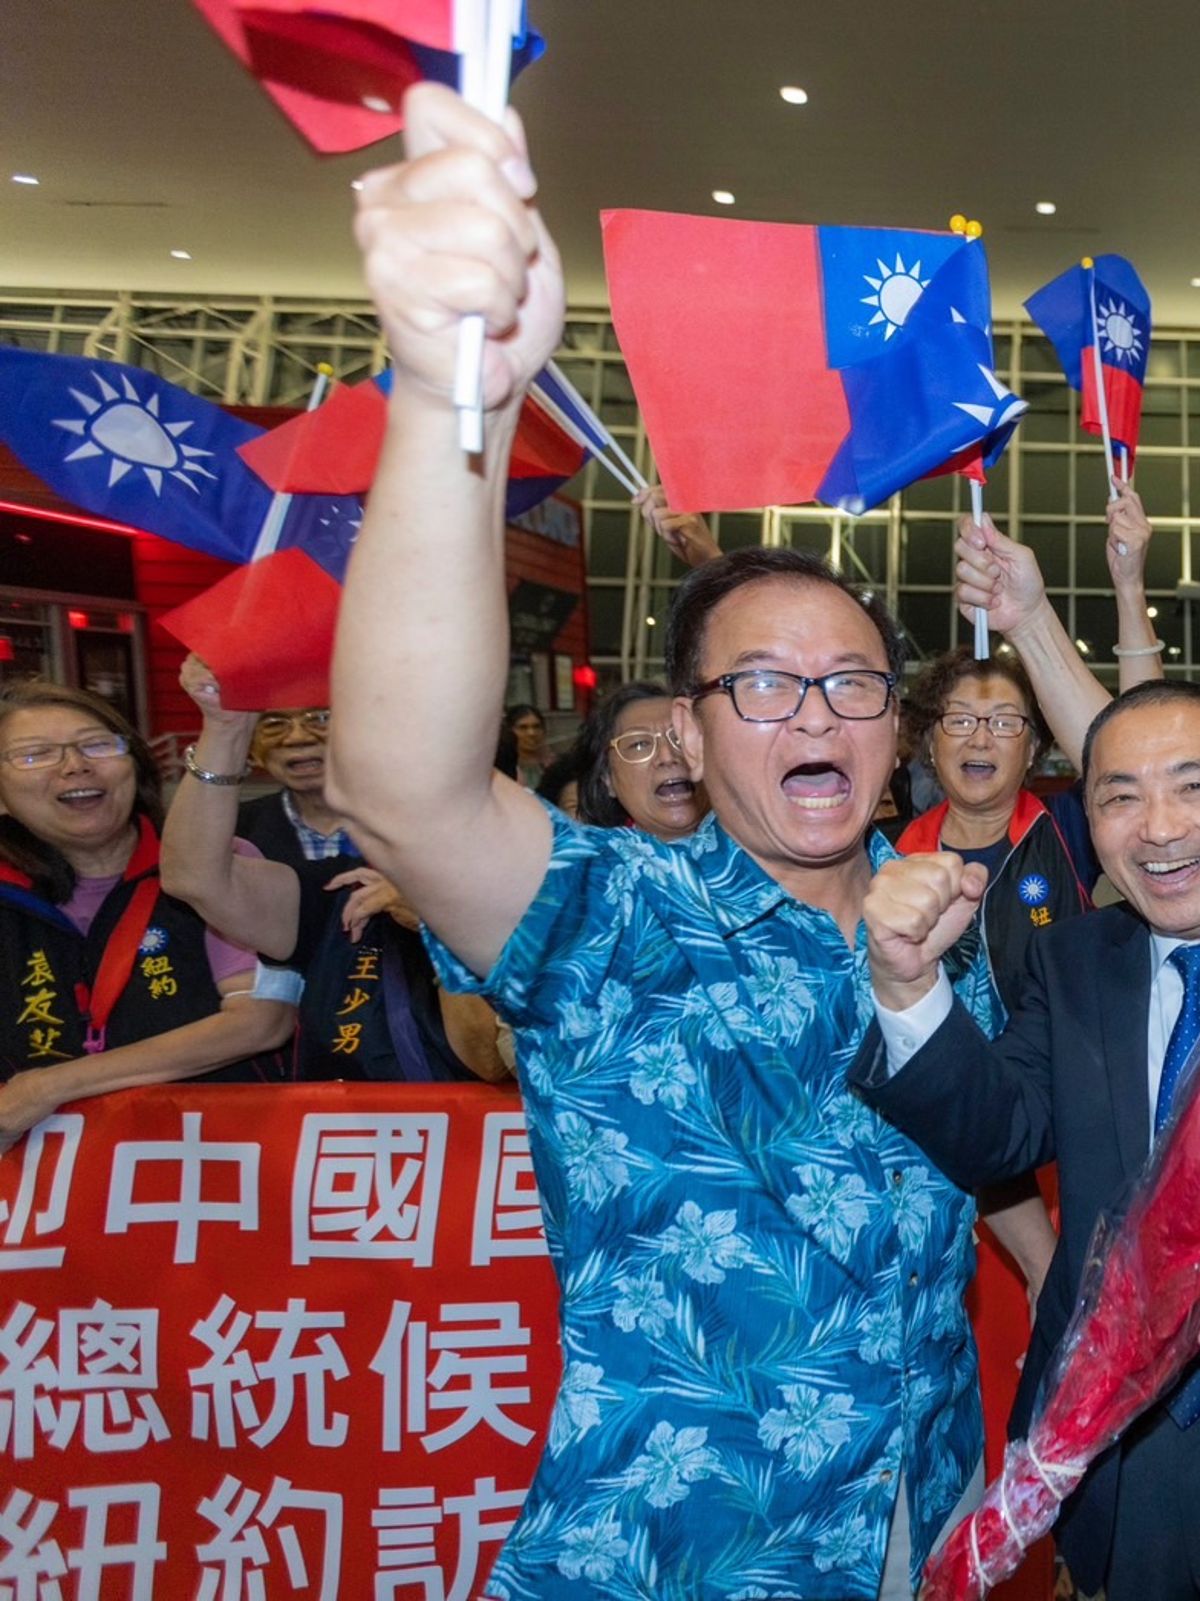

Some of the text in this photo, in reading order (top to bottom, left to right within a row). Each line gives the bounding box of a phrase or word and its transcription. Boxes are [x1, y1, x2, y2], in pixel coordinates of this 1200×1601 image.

[140, 956, 178, 999] 紐約
[332, 956, 379, 1054] 王少男
[0, 1293, 536, 1460] 總統候
